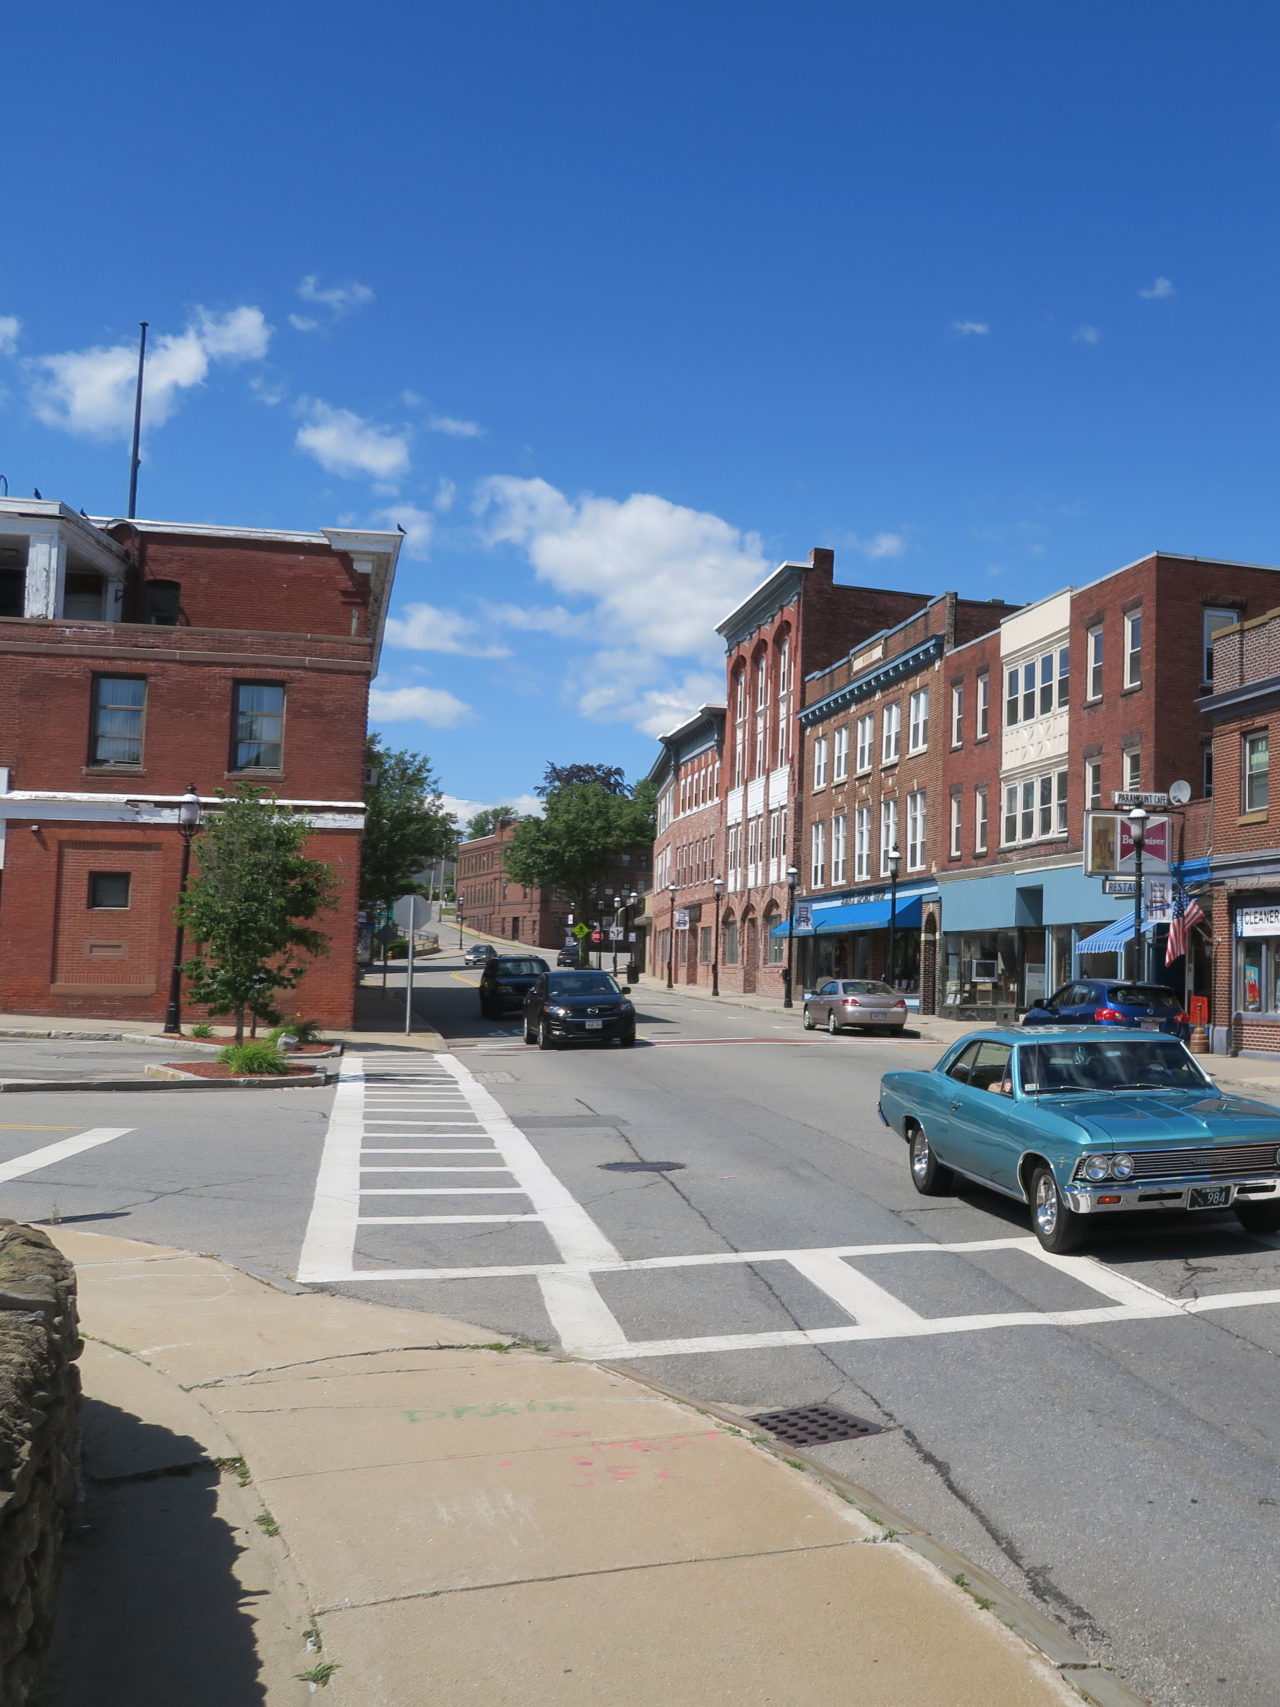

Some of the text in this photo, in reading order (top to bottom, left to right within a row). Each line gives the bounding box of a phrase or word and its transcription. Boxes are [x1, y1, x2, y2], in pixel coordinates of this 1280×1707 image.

[1117, 792, 1168, 805] PARAMUNT CAFE
[1122, 834, 1165, 846] Bueiser
[1207, 1191, 1226, 1204] 984
